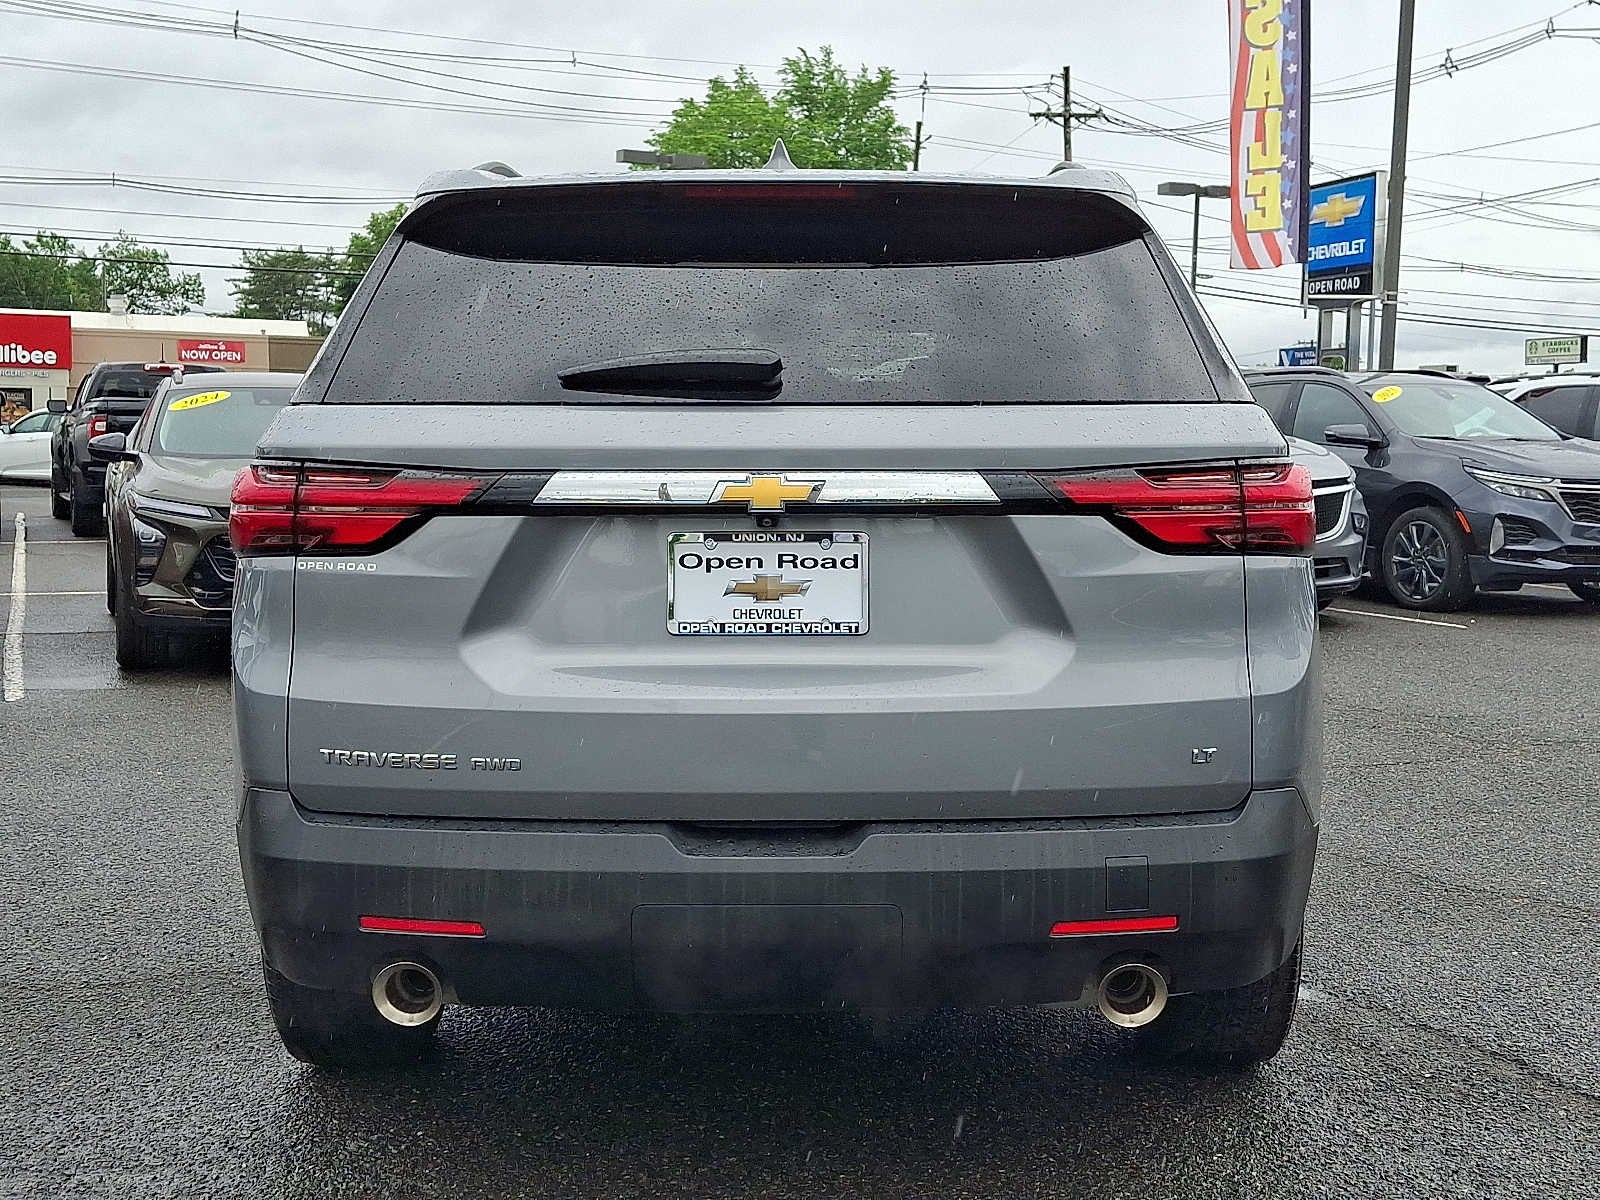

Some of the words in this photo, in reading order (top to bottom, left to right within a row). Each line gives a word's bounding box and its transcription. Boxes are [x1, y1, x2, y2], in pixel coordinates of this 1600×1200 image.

[1307, 238, 1367, 262] CHEVROLET
[1308, 280, 1333, 294] OPEN
[1334, 276, 1361, 292] ROAD
[1542, 340, 1579, 348] STARBUCKS
[1547, 346, 1571, 354] COFFEE
[181, 349, 210, 360] NOW
[211, 351, 241, 361] OPEN
[785, 533, 805, 542] NJ
[297, 561, 334, 571] OPEN
[336, 562, 377, 572] ROAD
[678, 553, 764, 573] Open
[777, 553, 859, 569] Road
[732, 608, 804, 620] CHEVROLET
[679, 622, 722, 633] OPEN
[725, 622, 768, 633] ROAD
[771, 622, 859, 633] CHEVROLET
[319, 747, 458, 770] TRAVERSE
[470, 757, 522, 772] AWD
[1191, 747, 1218, 764] LT
